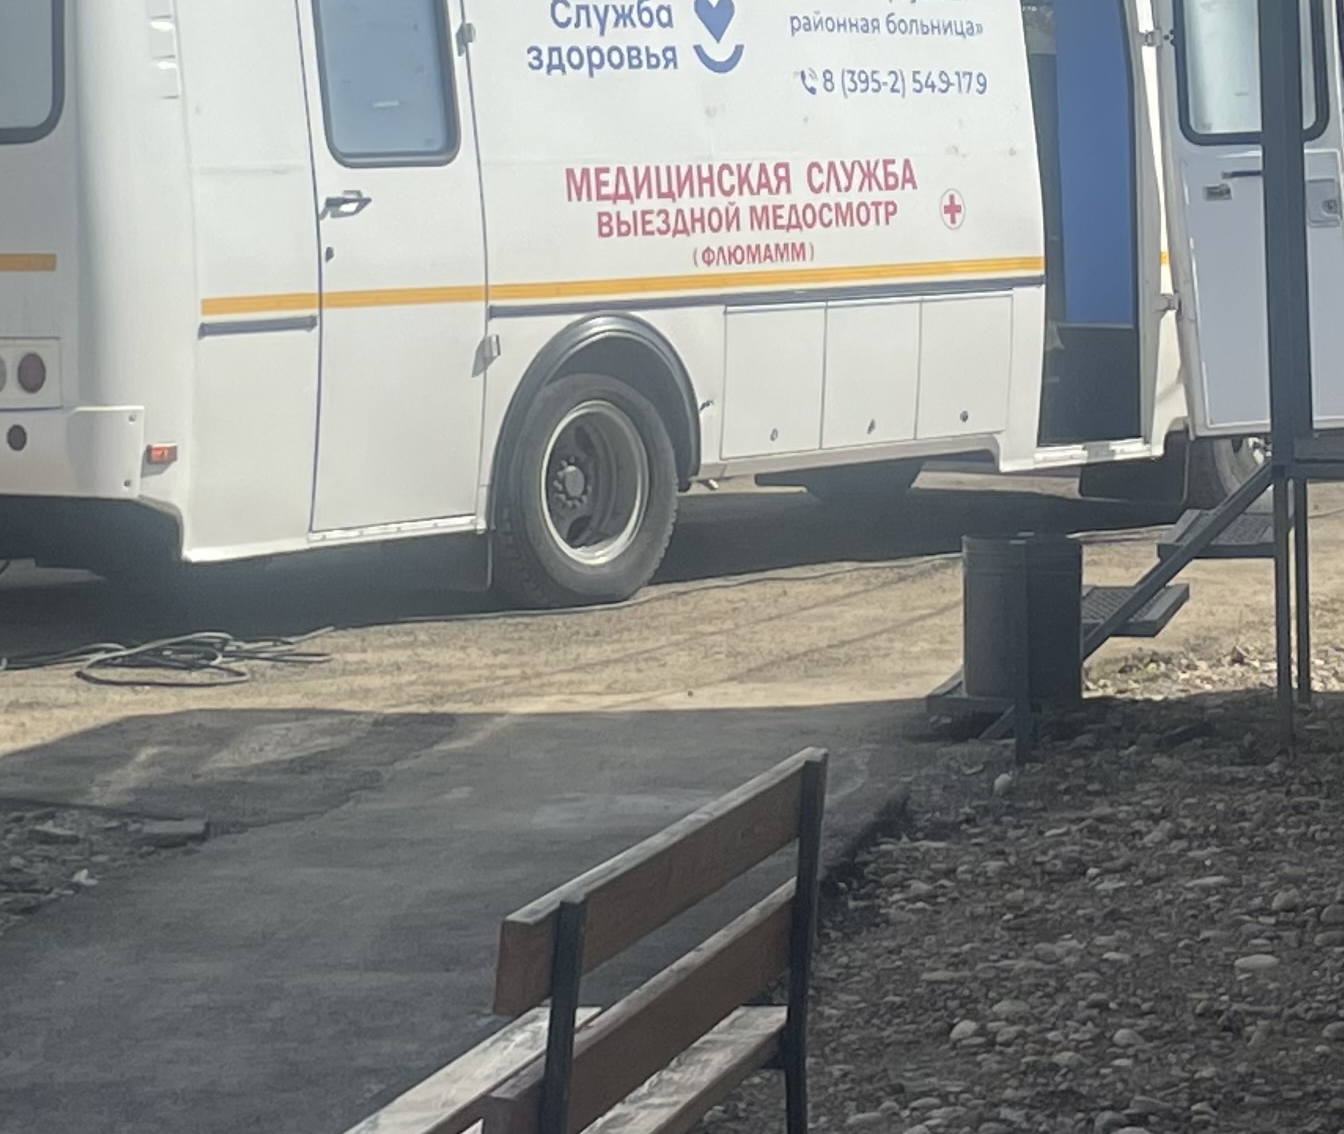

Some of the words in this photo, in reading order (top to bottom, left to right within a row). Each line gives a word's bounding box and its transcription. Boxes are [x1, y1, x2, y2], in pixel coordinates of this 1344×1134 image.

[790, 11, 881, 36] районная
[885, 12, 984, 39] больница»
[527, 44, 678, 78] здоровья
[822, 69, 835, 92] 8
[841, 68, 906, 99] (395-2)
[911, 70, 988, 95] 549-179
[565, 161, 792, 205] МЕДИЦИНСКАЯ
[806, 157, 918, 195] СЛУЖБА
[597, 202, 741, 238] ВЫЕЗДНОЙ
[749, 200, 898, 232] МЕДОСМОТР
[693, 241, 815, 267] (ФЛЮМАММ)
